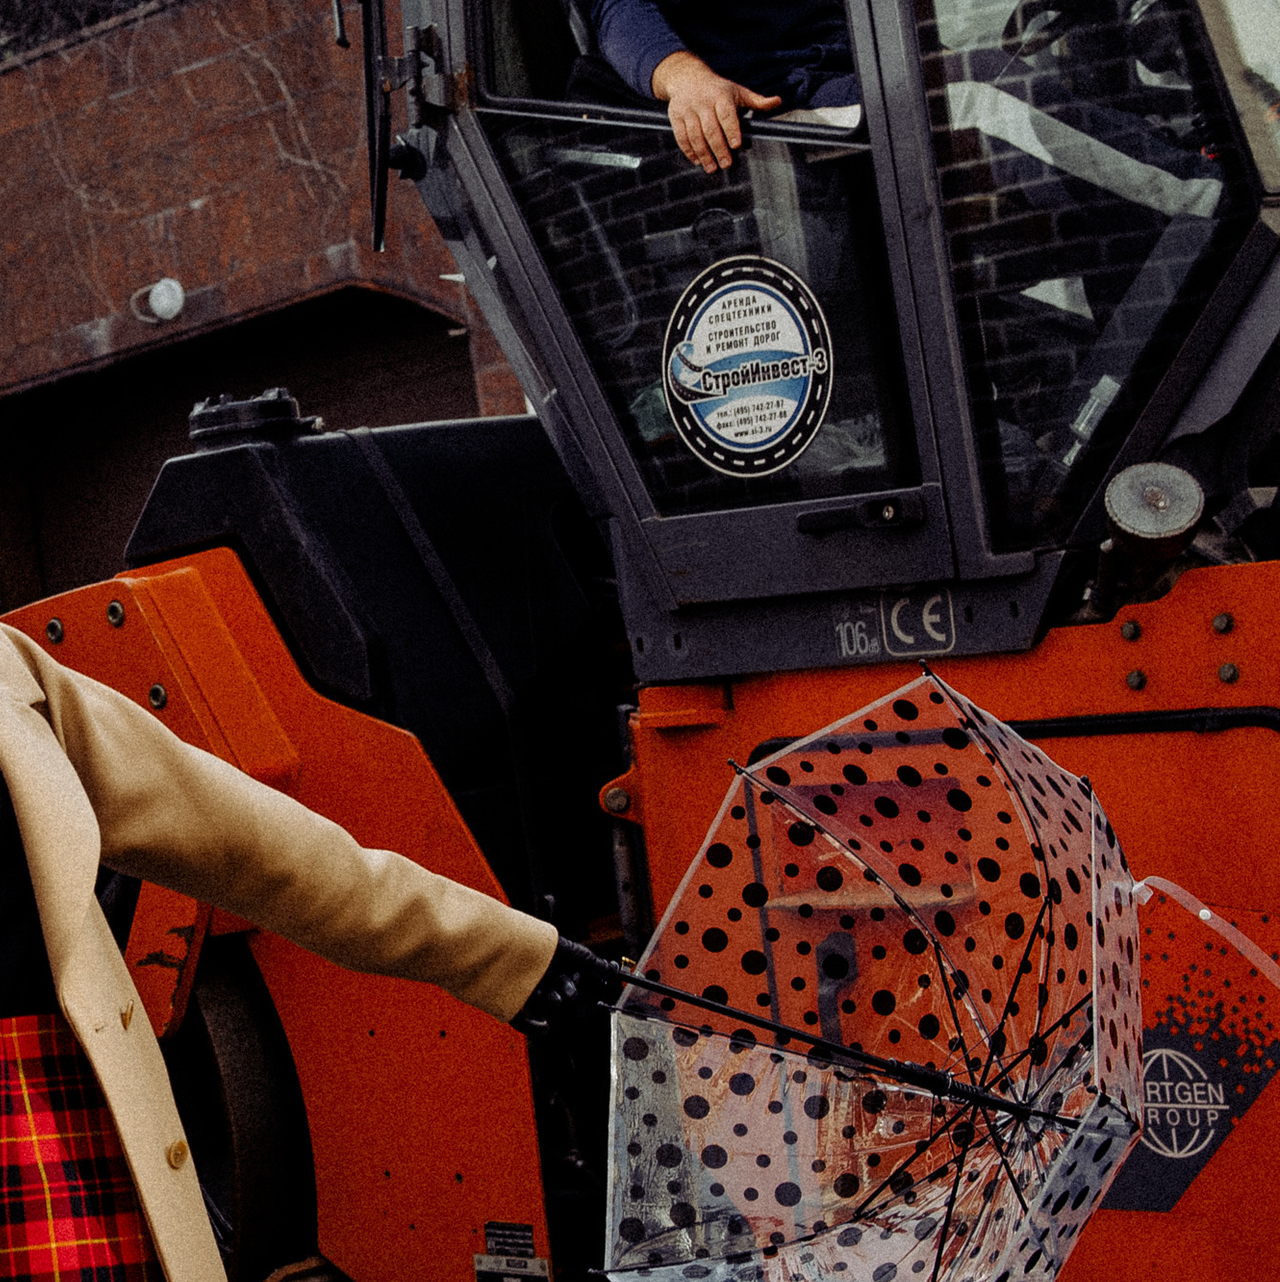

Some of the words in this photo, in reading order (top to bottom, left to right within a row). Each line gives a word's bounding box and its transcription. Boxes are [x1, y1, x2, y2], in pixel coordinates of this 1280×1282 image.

[722, 295, 757, 310] АРЕНДА
[708, 304, 772, 325] СПЕЦТЕХНИКИ
[708, 320, 777, 342] СТРОИТЕЛЬСТВО
[706, 344, 711, 354] И
[716, 338, 748, 352] РЕМОНТ
[753, 331, 781, 347] ДОРОГ
[701, 350, 826, 396] СтройИнвест-3
[733, 405, 750, 417] (495)
[736, 416, 754, 428] (495)
[835, 621, 869, 657] 106
[1147, 1108, 1219, 1127] ROUP
